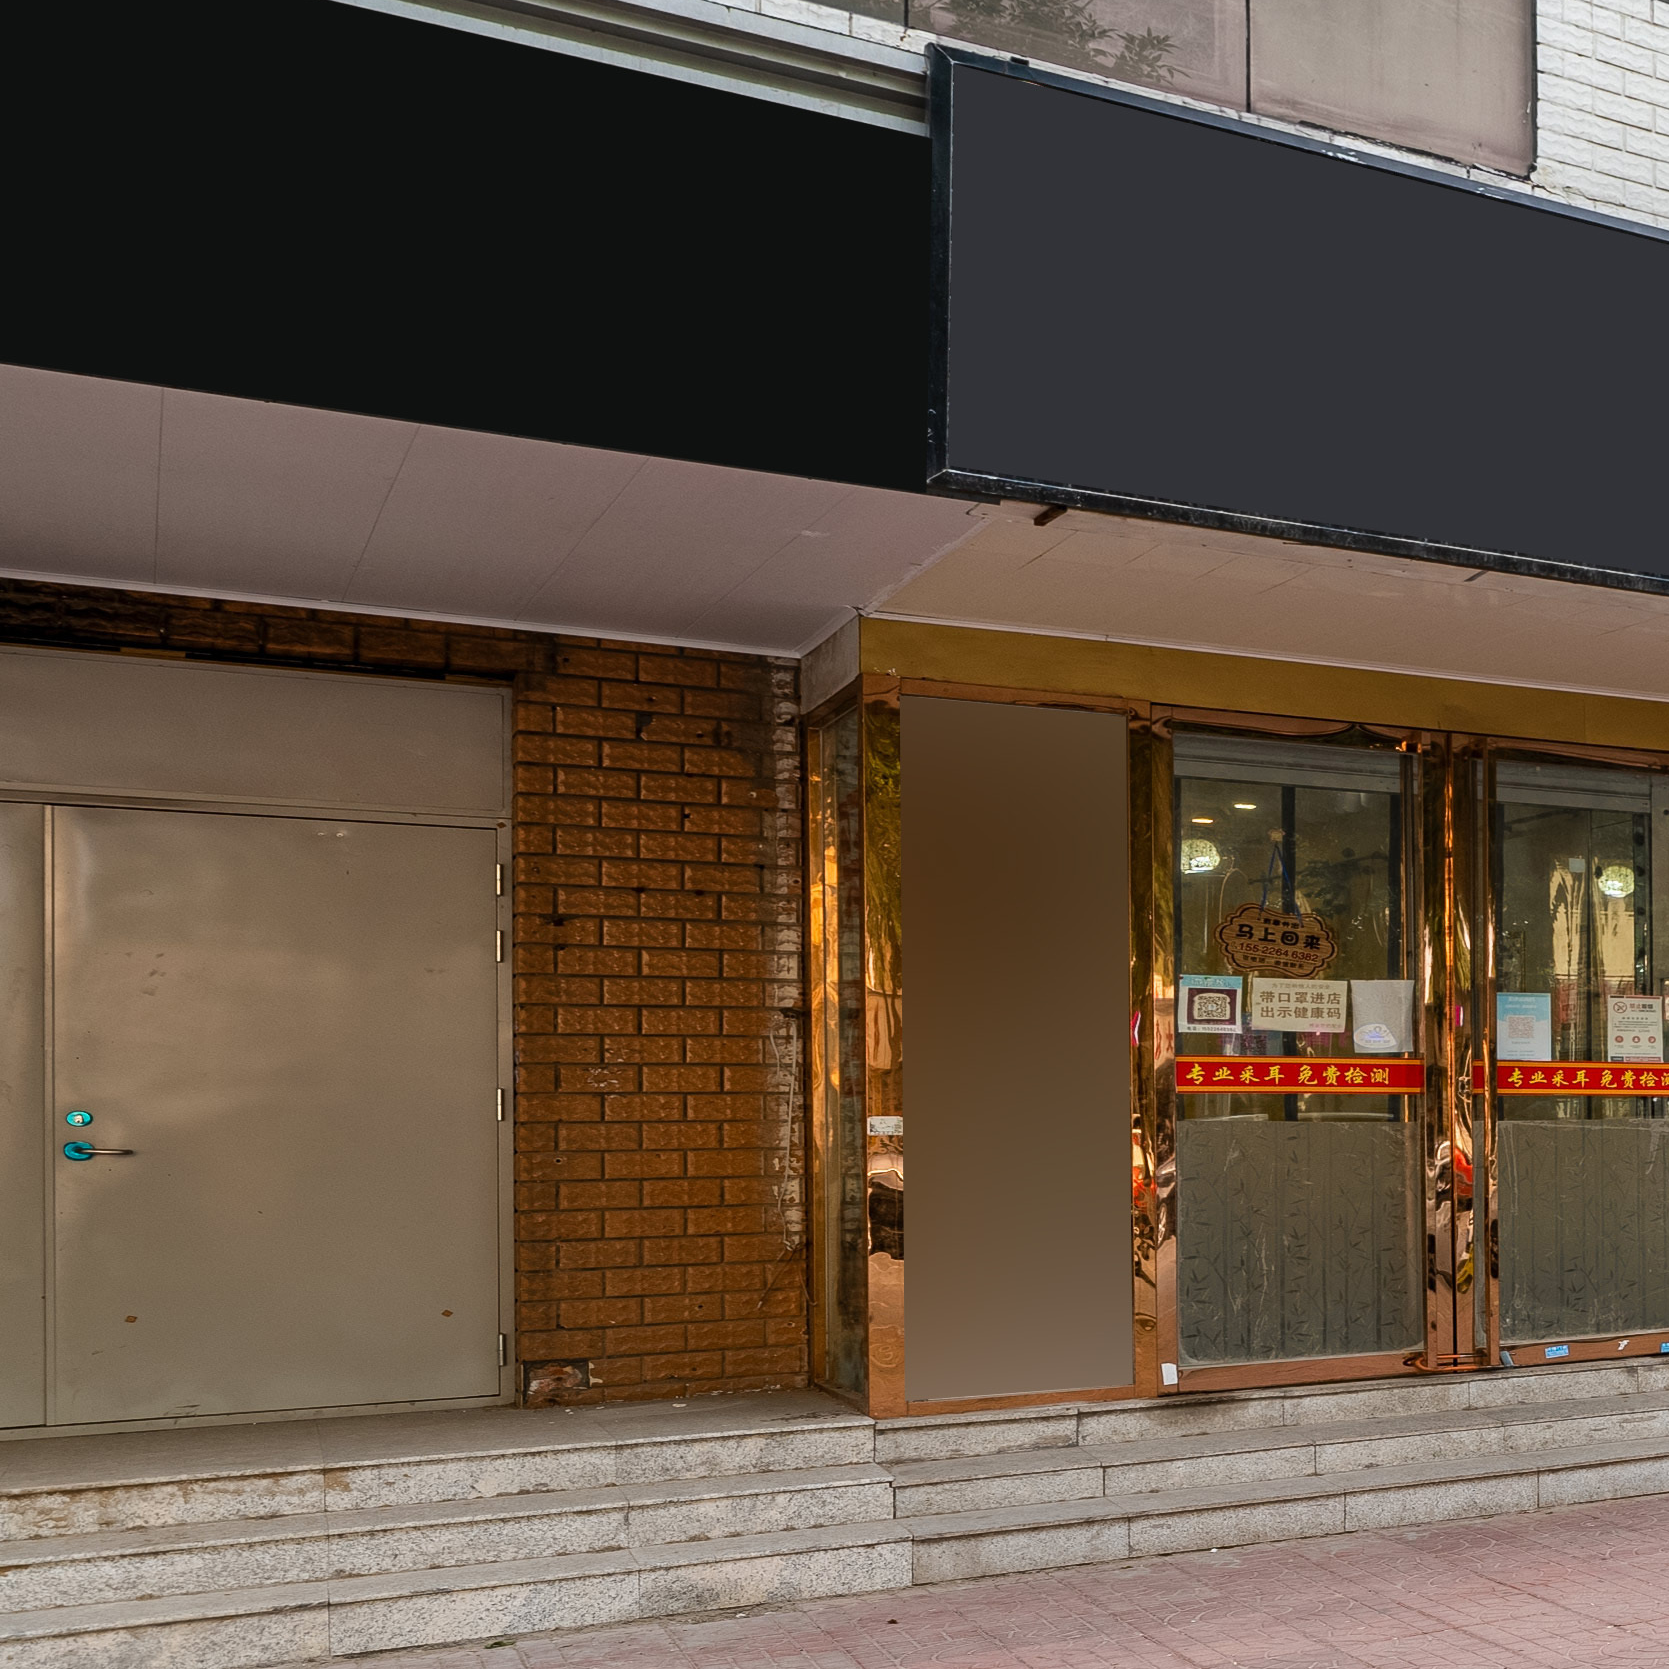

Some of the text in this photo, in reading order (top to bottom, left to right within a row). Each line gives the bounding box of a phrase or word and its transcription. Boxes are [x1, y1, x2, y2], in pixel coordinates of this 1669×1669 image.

[1236, 924, 1320, 950] 马上回来
[1240, 943, 1319, 962] 155 2264 6382
[1259, 991, 1341, 1005] 带口罩进店
[1260, 1006, 1341, 1019] 出示健康码
[1185, 1063, 1390, 1086] 专业采耳 免费检测
[1507, 1067, 1590, 1088] 专业采耳
